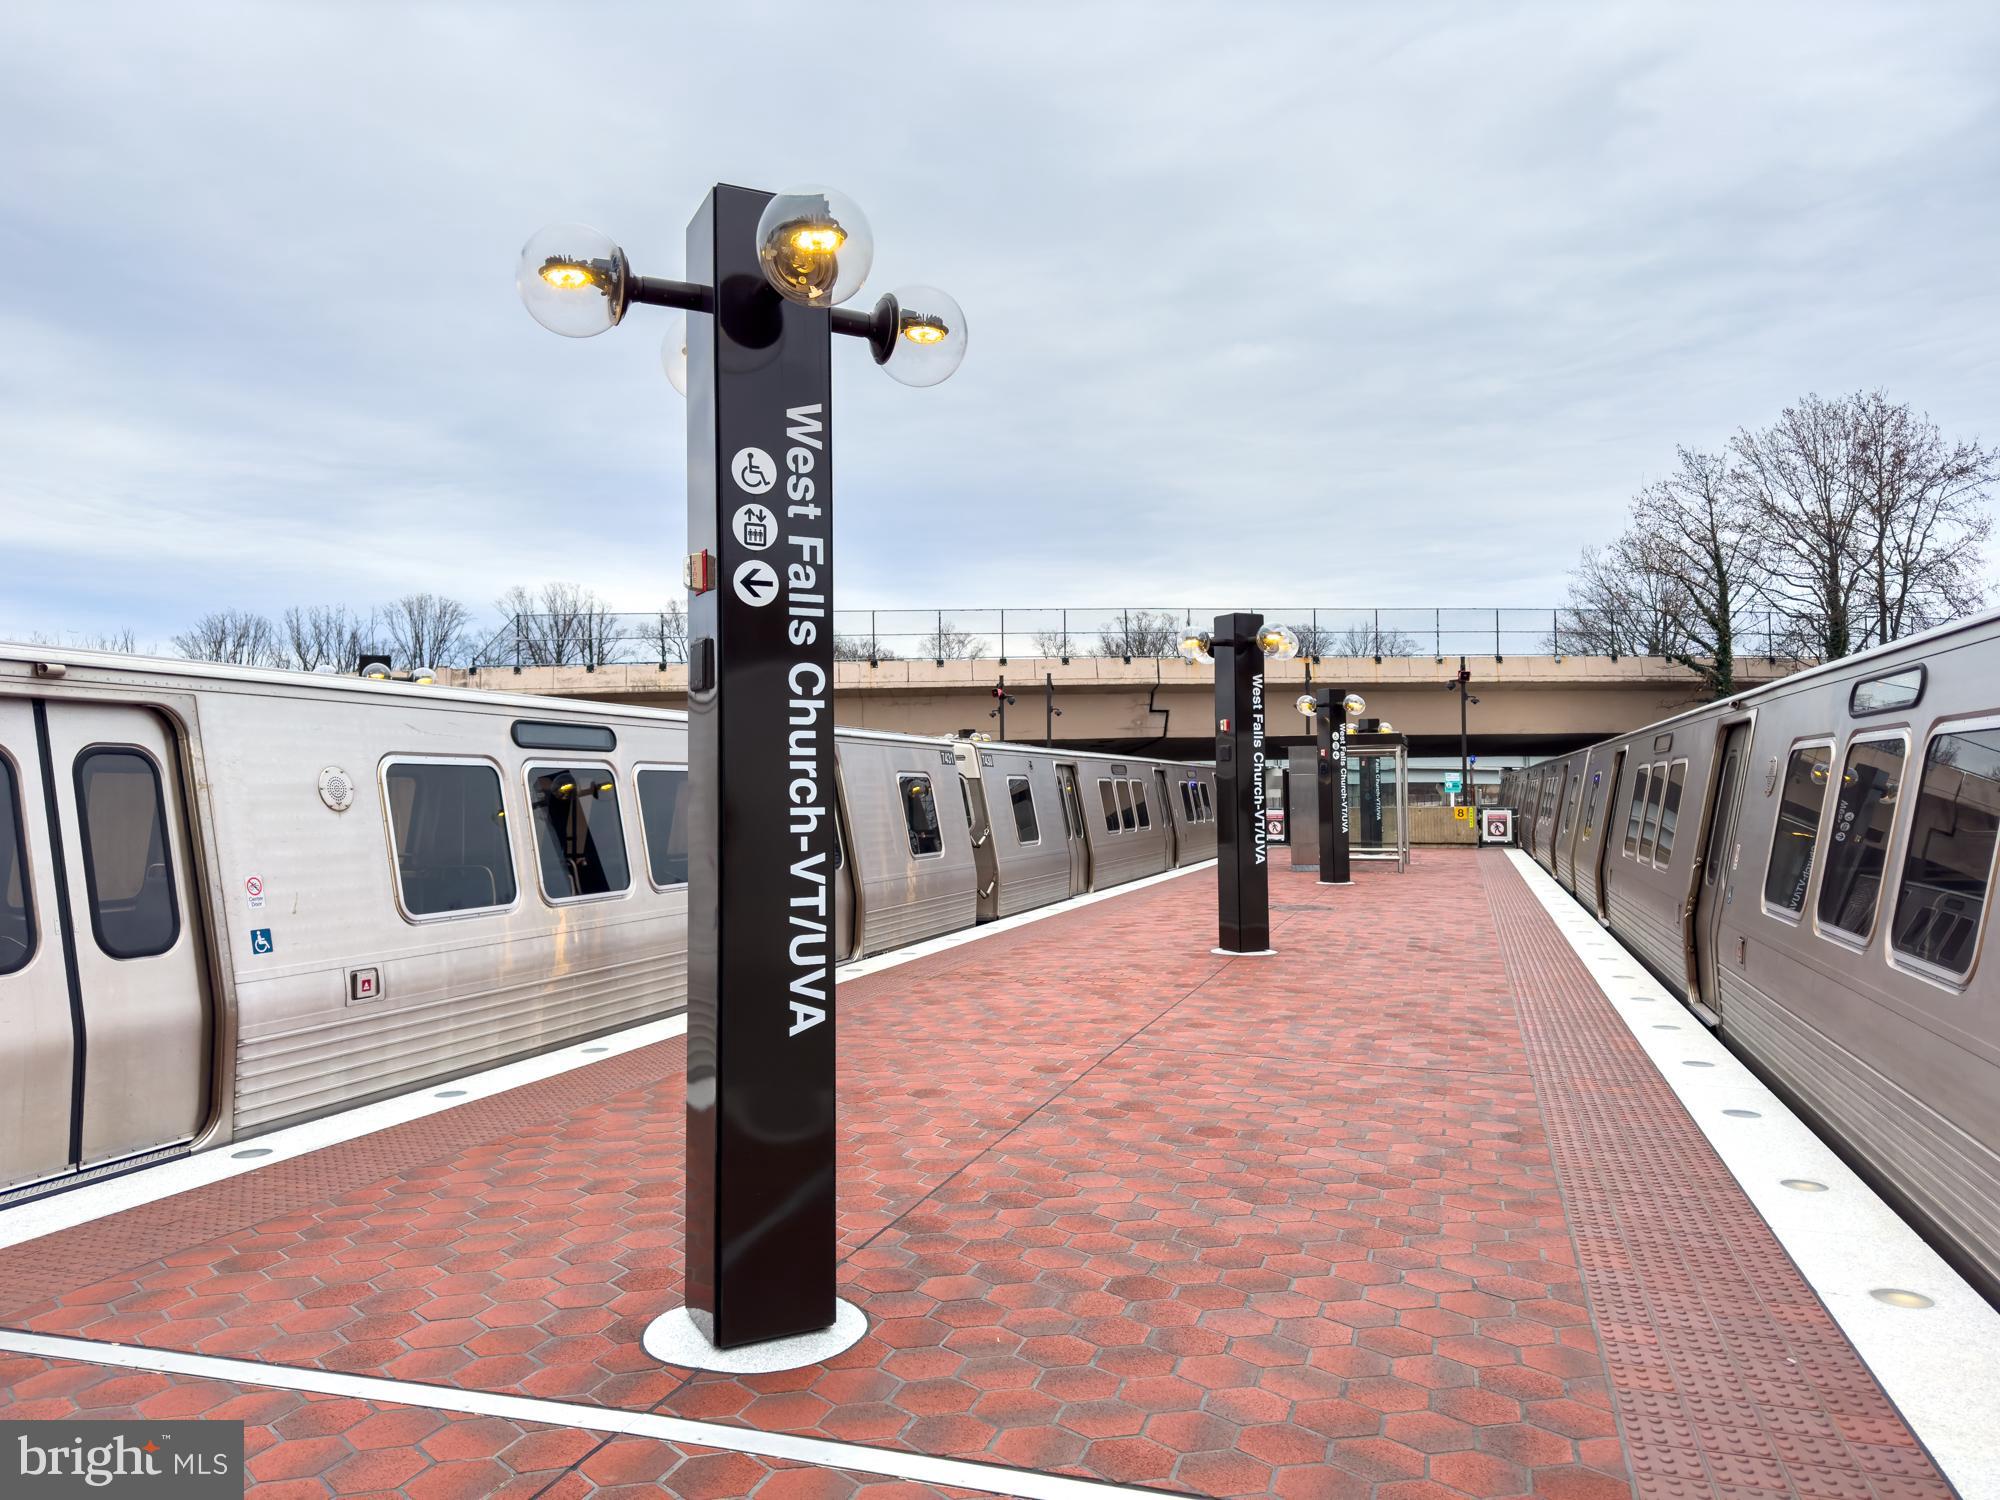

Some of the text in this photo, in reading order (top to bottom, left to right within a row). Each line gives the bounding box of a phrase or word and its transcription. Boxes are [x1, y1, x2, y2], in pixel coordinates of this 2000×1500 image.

[786, 403, 827, 1037] West Falls Church-VT/UVA
[1253, 673, 1266, 865] West Falls Church-VT/UVA
[1341, 768, 1349, 834] Church-VT/UVA
[1457, 809, 1464, 817] 8
